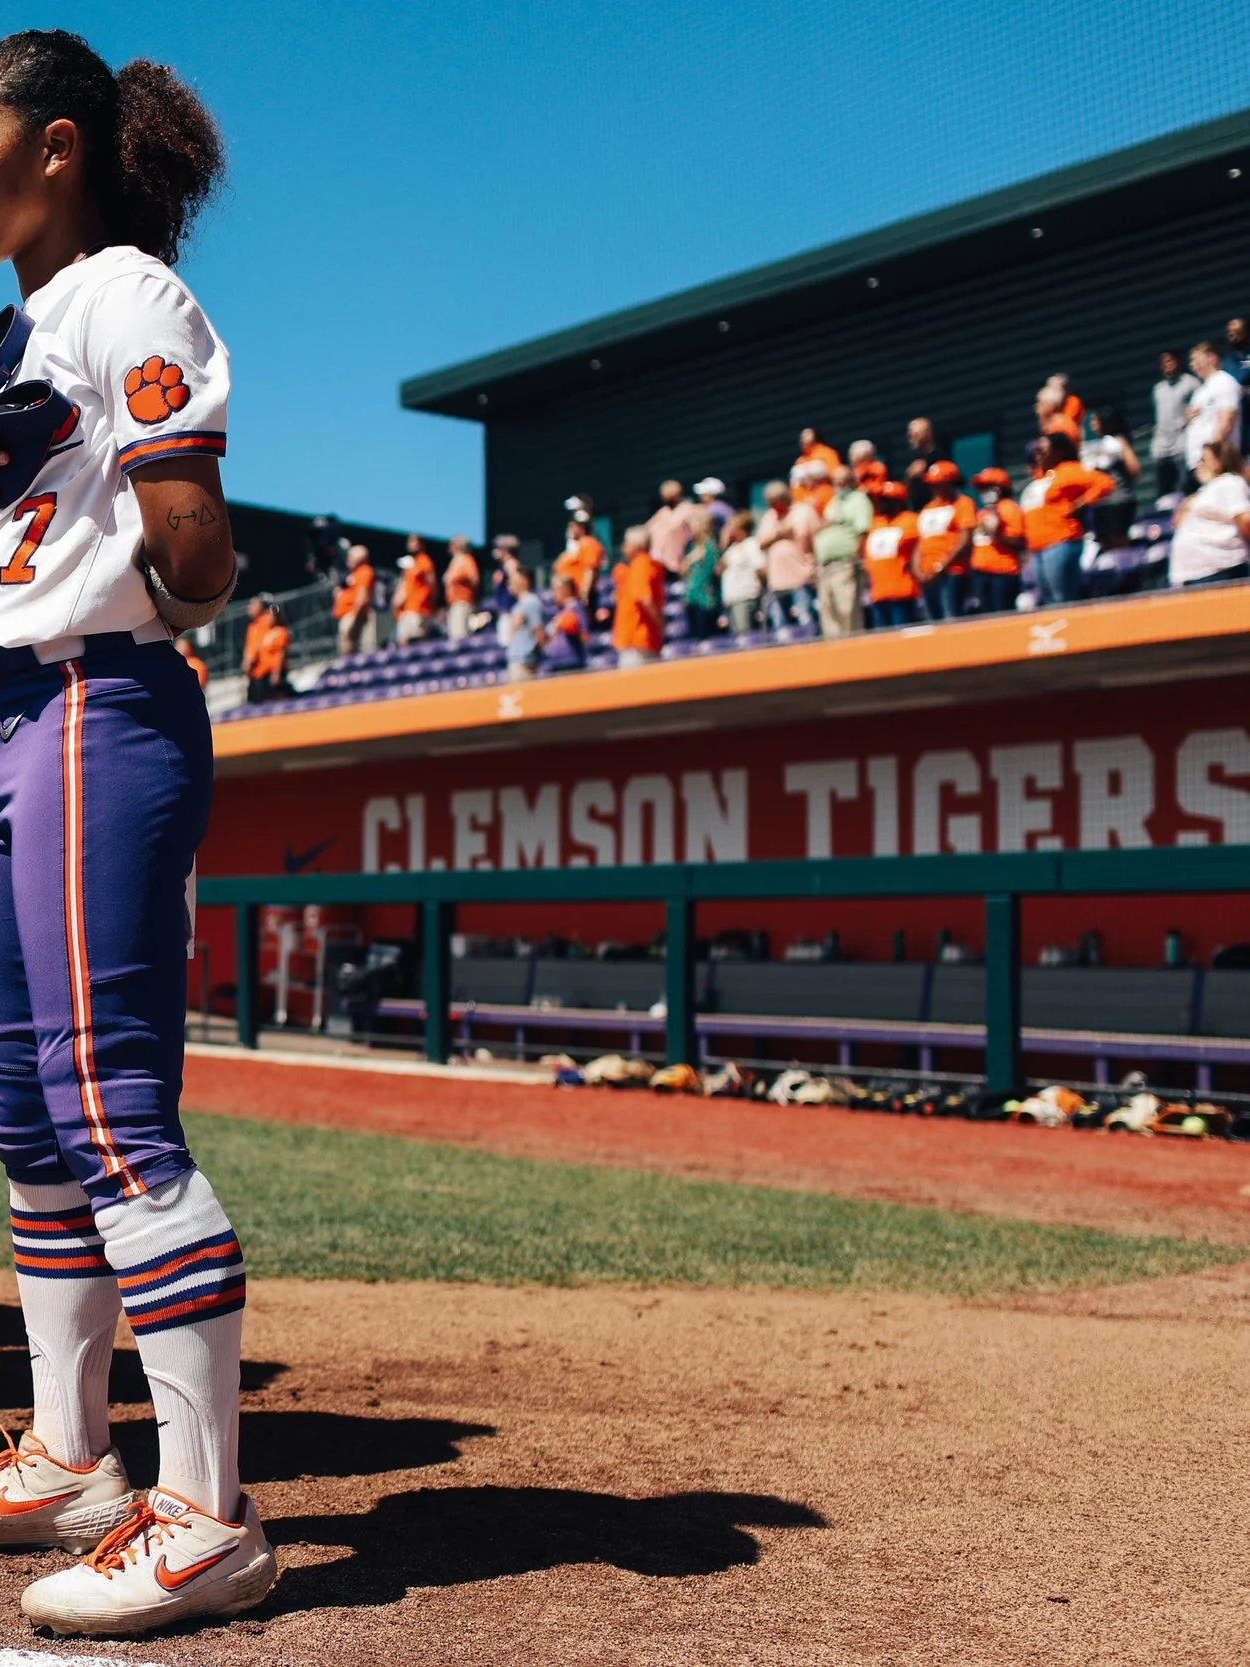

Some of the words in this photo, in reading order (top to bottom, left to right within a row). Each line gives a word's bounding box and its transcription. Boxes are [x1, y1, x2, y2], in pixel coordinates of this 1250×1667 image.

[0, 491, 57, 585] 7
[362, 768, 749, 875] CLEMSON
[784, 728, 1250, 860] TIGERS
[156, 1499, 183, 1518] NIKE
